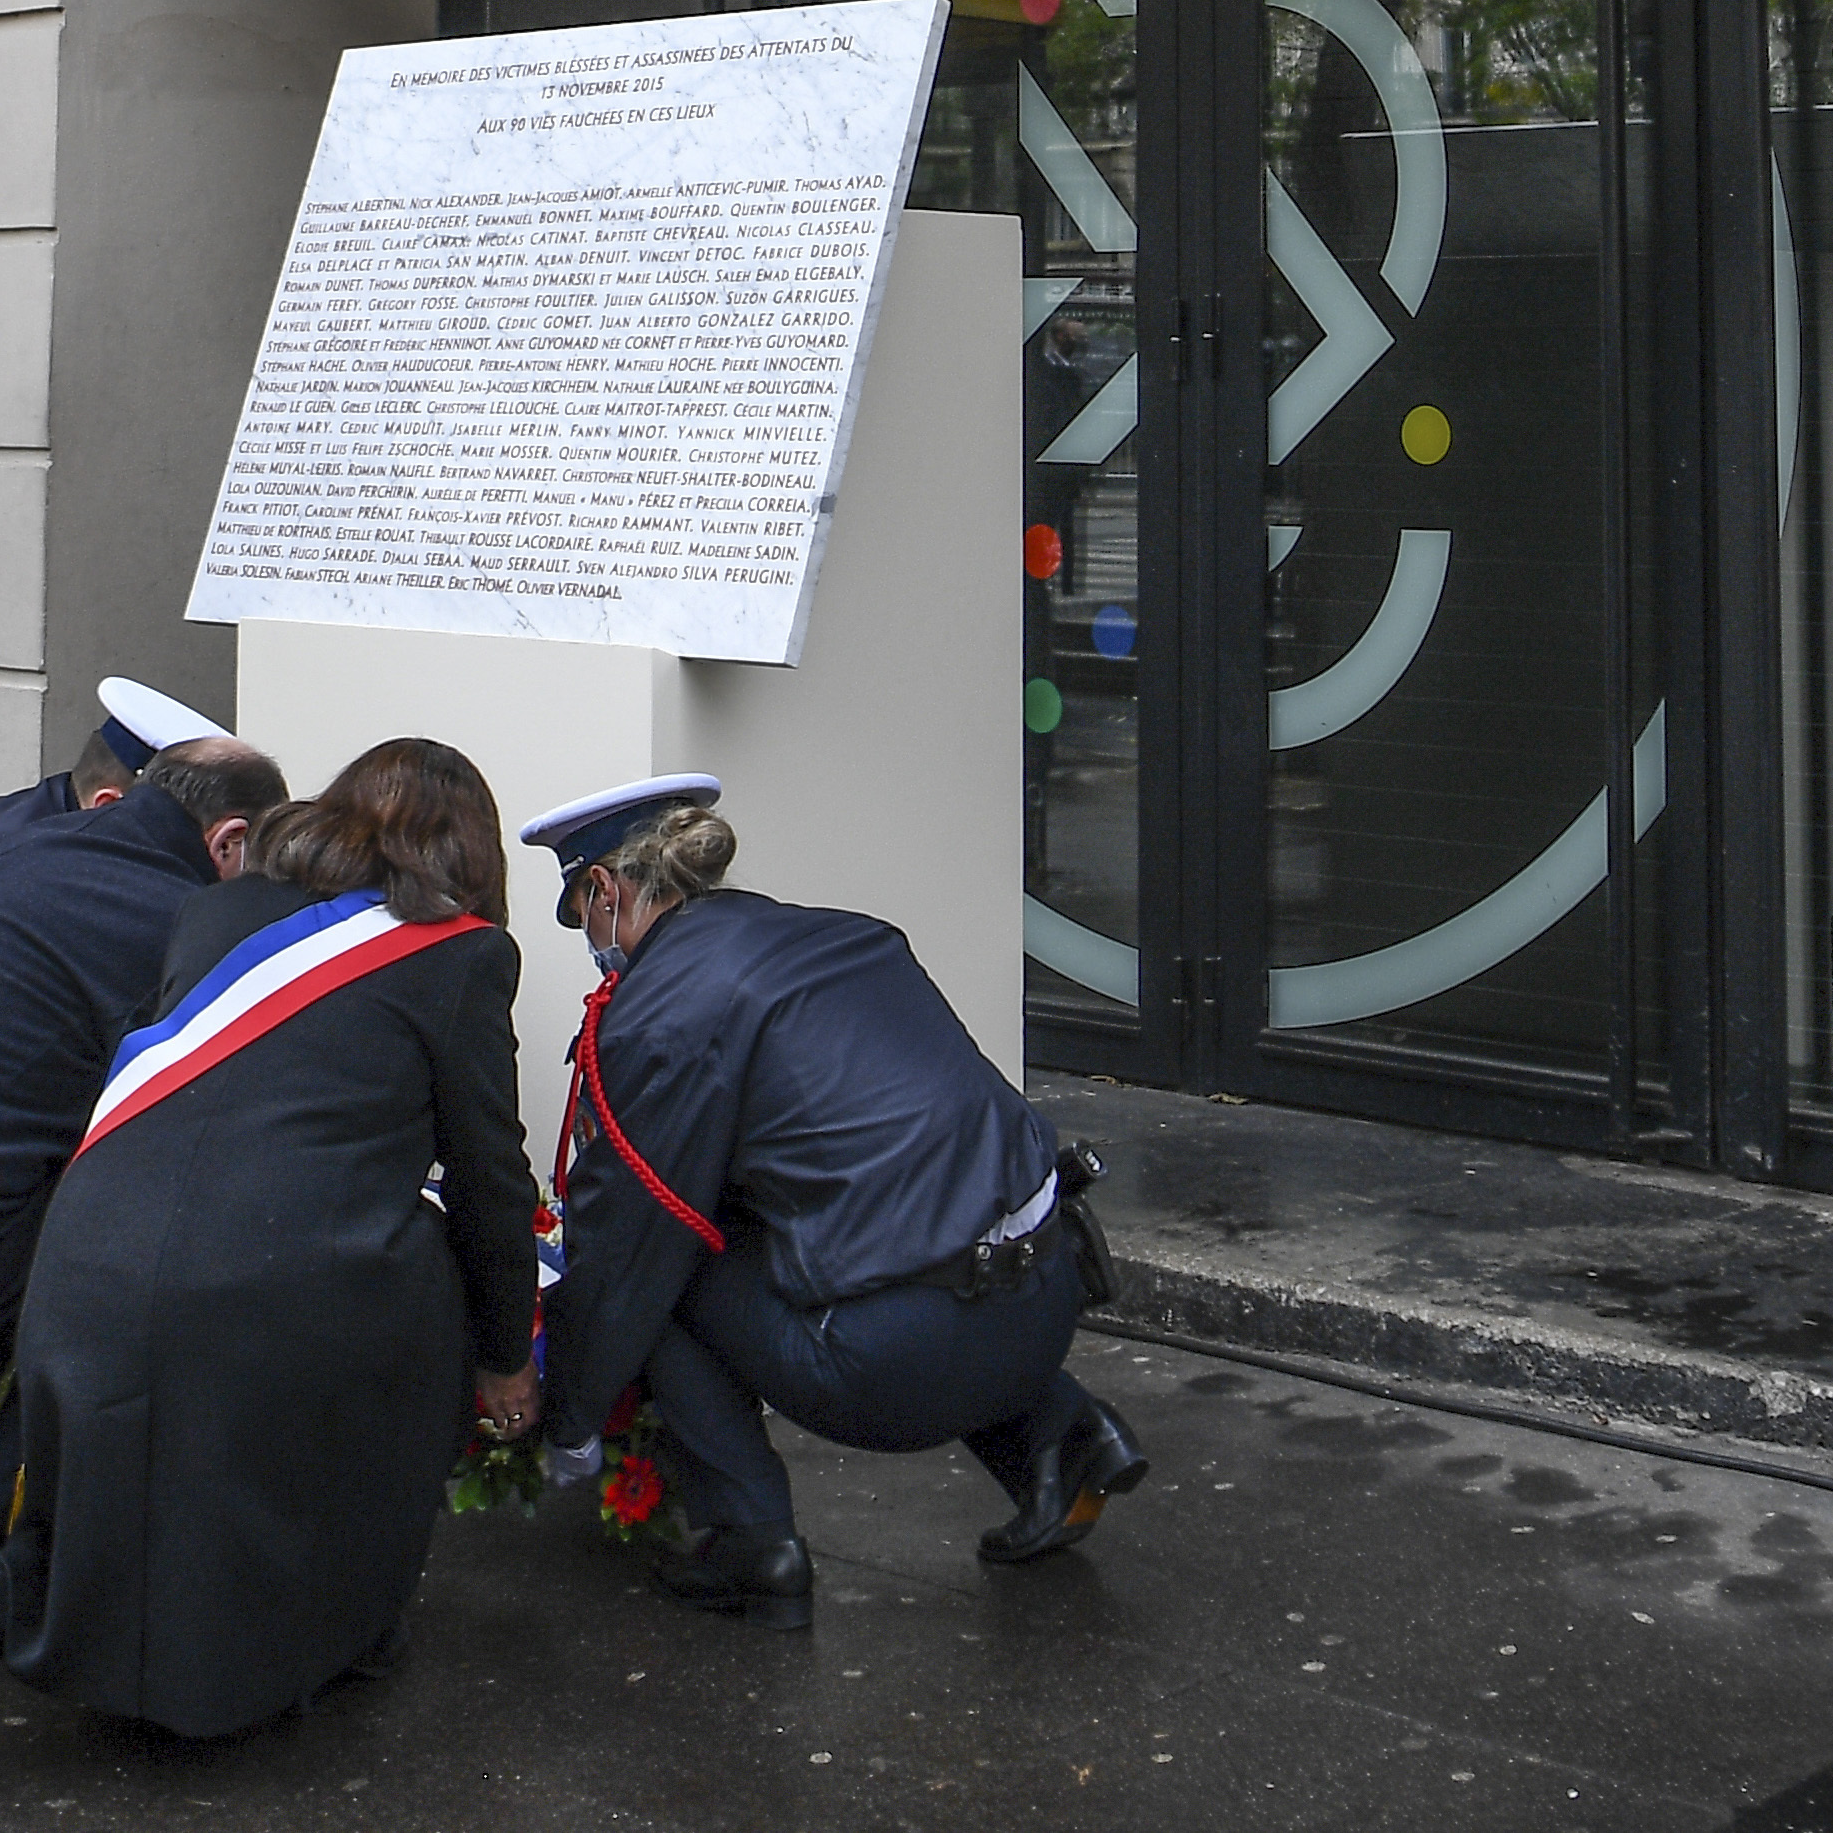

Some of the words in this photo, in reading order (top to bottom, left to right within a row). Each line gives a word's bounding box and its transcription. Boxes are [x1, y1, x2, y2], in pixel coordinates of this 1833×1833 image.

[389, 72, 408, 88] EN
[467, 66, 492, 82] DES
[495, 61, 551, 79] VICTIMES
[612, 54, 630, 70] ET
[718, 43, 745, 60] DES
[746, 37, 827, 58] ATTENTATS
[830, 35, 853, 51] DU
[540, 84, 556, 99] 13
[558, 78, 629, 97] NOVEMBRE
[631, 75, 664, 92] 2015
[476, 118, 507, 134] AUX
[509, 116, 526, 132] 90
[530, 113, 557, 130] VIES
[626, 108, 646, 123] EN
[648, 105, 673, 122] CES
[675, 103, 715, 120] LIEUX
[316, 257, 373, 272] DELPLACE
[376, 258, 390, 271] ET
[393, 257, 441, 270] PATRICIA
[445, 254, 471, 269] SAN
[533, 253, 576, 267] ALBAN
[638, 249, 690, 263] VINCENT
[752, 245, 803, 260] FABRICE
[282, 280, 321, 293] ROMAIN
[368, 277, 409, 291] THOMAS
[481, 274, 528, 288] MATHIAS
[532, 271, 595, 287] DYMARSKI
[598, 273, 612, 285] ET
[615, 271, 651, 284] MARIE
[714, 268, 751, 283] SALEH
[754, 267, 789, 282] EMAD
[271, 319, 310, 332] MAYEUL
[378, 318, 432, 331] MATTHIEU
[598, 314, 631, 330] JUAN
[636, 315, 691, 328] ALBERTO
[697, 310, 774, 328] GONZALEZ
[221, 499, 259, 514] FRANCK
[303, 503, 353, 518] CAROLINE
[567, 513, 618, 529] RICHARD
[700, 518, 758, 535] VALENTIN
